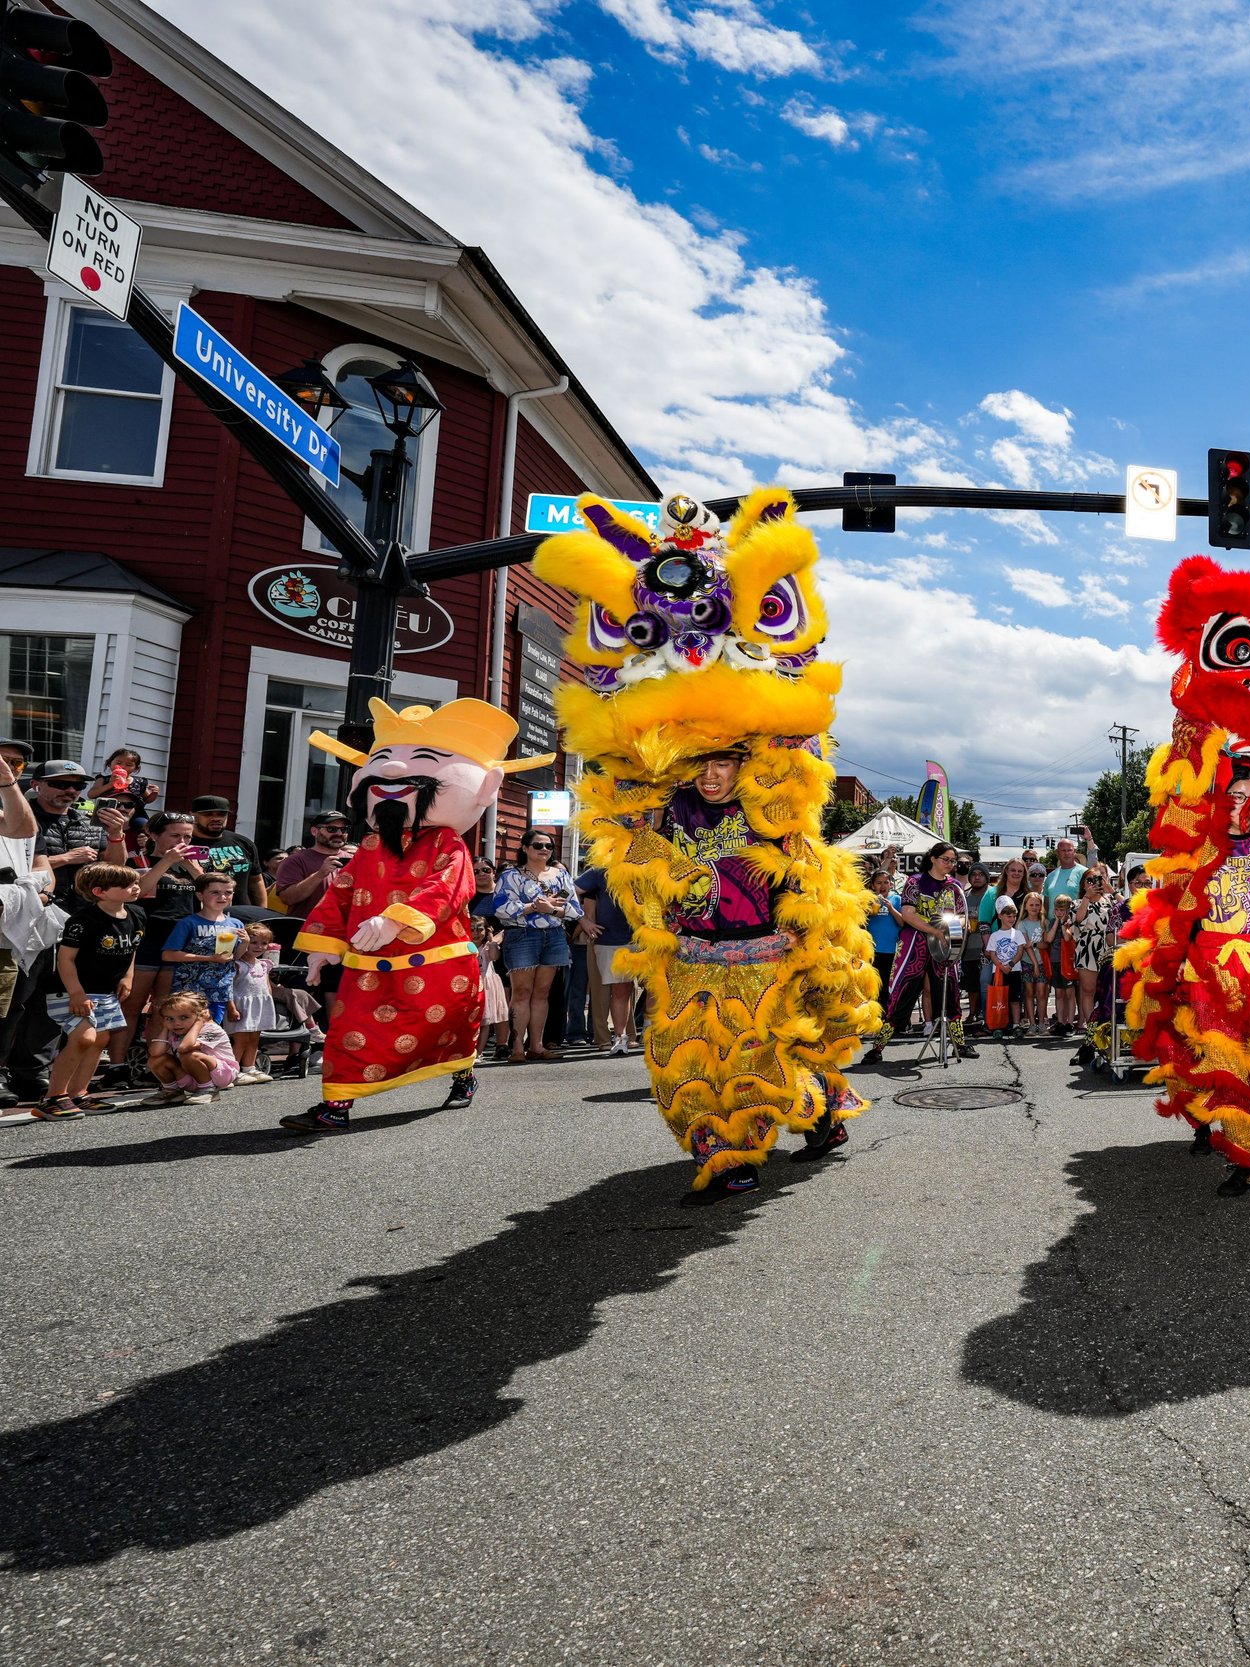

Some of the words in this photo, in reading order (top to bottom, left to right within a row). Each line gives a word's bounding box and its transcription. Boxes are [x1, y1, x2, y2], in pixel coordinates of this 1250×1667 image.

[84, 194, 118, 233] NO
[62, 230, 87, 258] ON
[93, 251, 125, 284] RED
[76, 214, 120, 259] TURN
[196, 330, 302, 445] University
[308, 430, 328, 462] Dr
[723, 837, 746, 850] WUN
